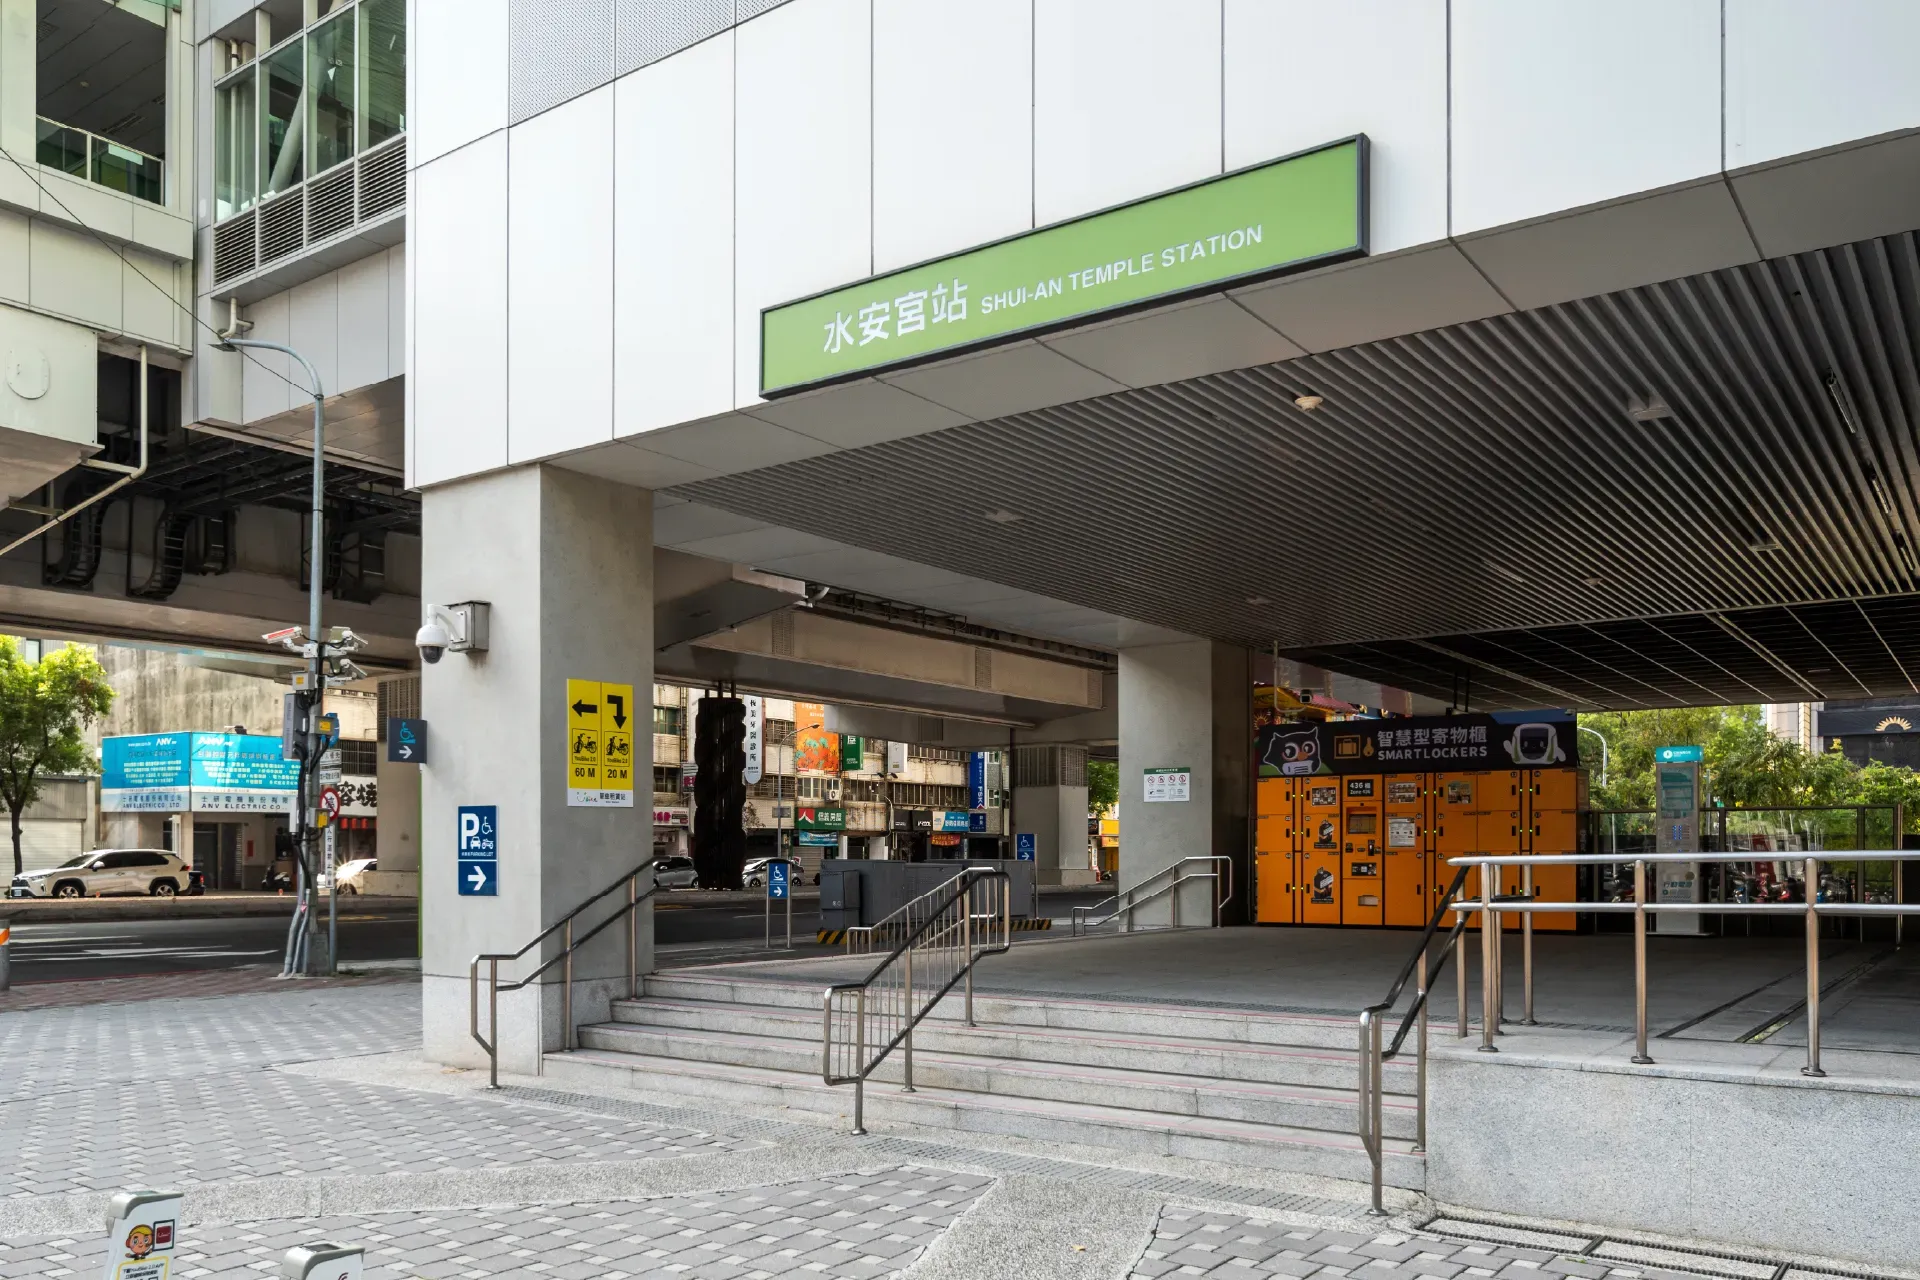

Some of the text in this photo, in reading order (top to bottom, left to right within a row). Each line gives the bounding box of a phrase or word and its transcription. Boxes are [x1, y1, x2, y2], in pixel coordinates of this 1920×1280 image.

[981, 224, 1265, 315] SHUI-AN TEMPLE STATION
[822, 277, 969, 354] 水安宮站
[155, 738, 173, 746] ANV
[1377, 725, 1488, 748] 智慧型寄物櫃
[1377, 746, 1488, 761] SMART LOCKERS
[575, 767, 595, 777] 60 M
[607, 769, 627, 779] 20 M
[818, 811, 842, 822] 信義房屋
[461, 813, 480, 850] P
